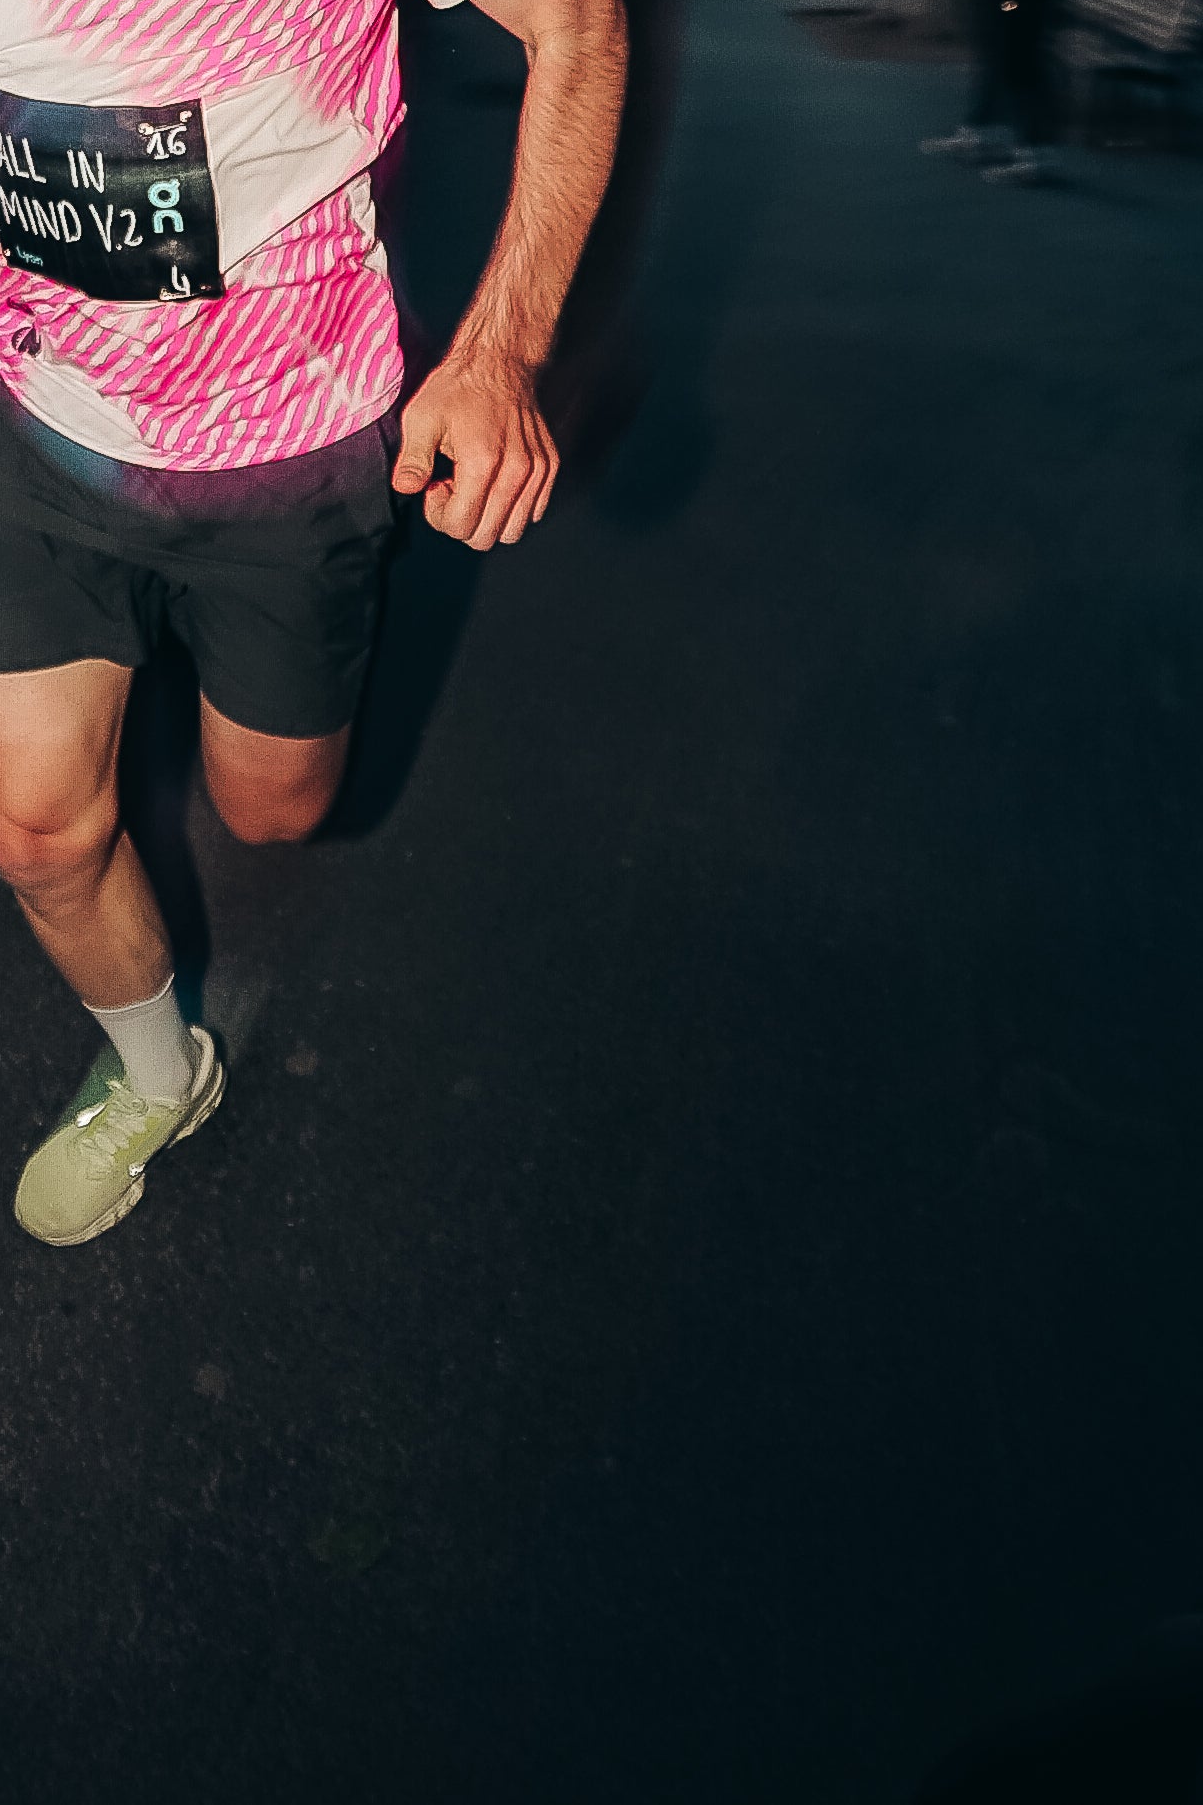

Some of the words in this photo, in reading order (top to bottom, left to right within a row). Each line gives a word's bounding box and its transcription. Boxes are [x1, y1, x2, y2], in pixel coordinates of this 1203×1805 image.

[146, 125, 187, 160] 16
[67, 149, 106, 194] IN
[89, 203, 144, 253] V.2
